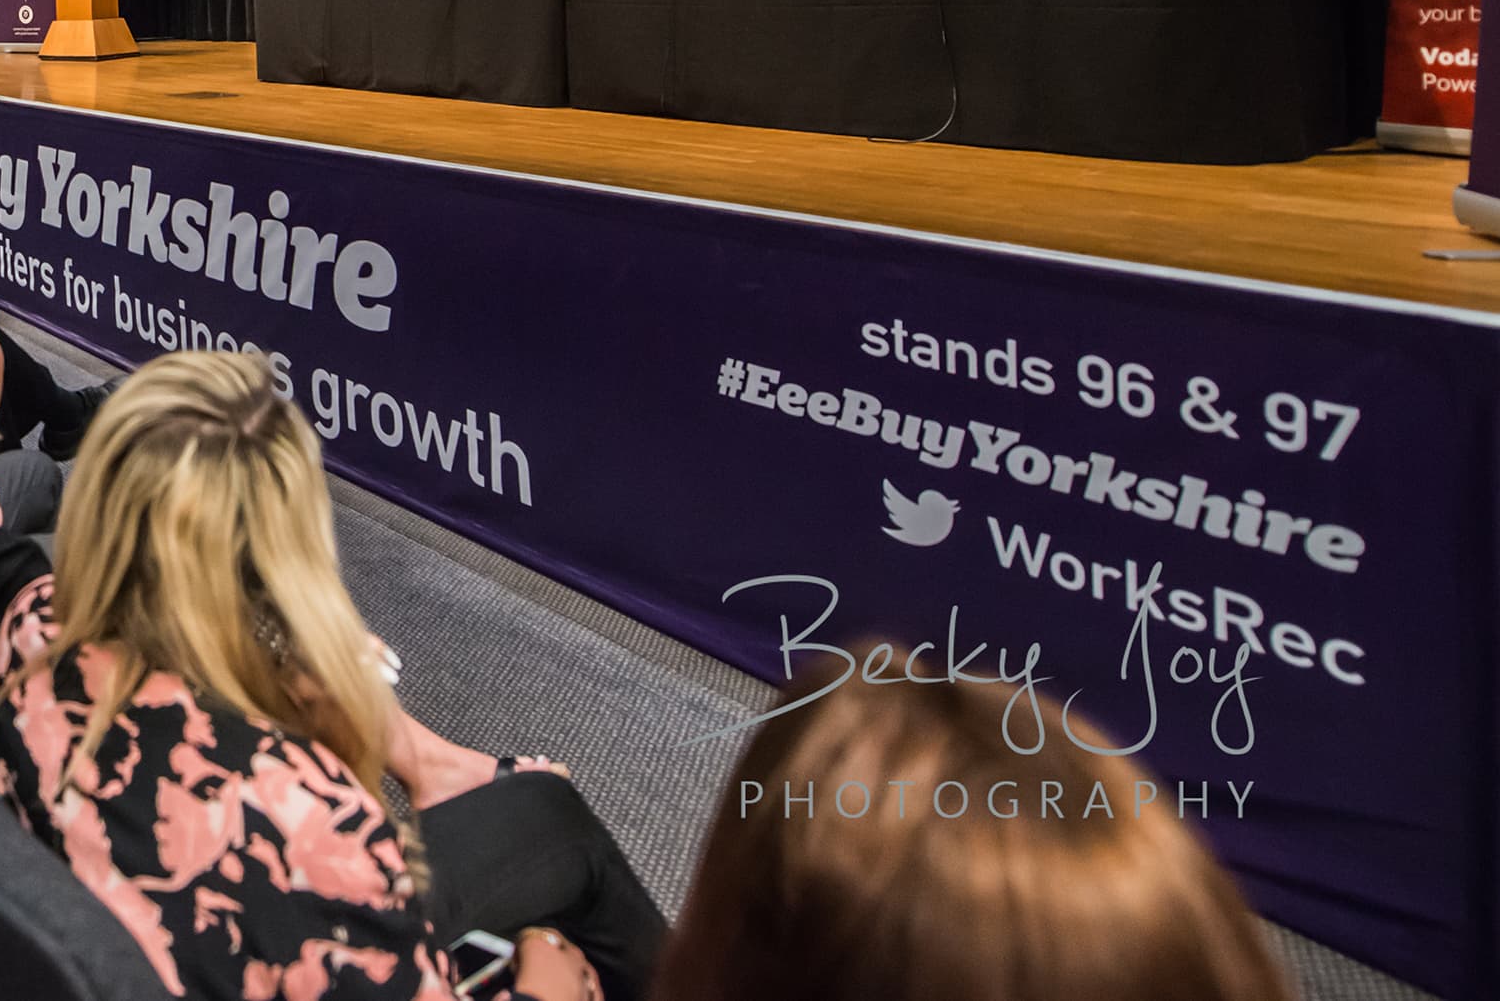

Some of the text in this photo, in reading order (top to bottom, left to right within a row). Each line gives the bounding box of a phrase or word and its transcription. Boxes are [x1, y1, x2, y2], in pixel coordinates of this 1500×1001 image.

[1419, 8, 1465, 25] your
[37, 144, 399, 333] Yorkshire
[63, 256, 106, 321] for
[310, 367, 534, 507] growth
[717, 357, 1366, 574] #EeeBuyYorkshire
[860, 318, 1362, 462] stands 96 & 97
[987, 515, 1366, 686] WorksRec
